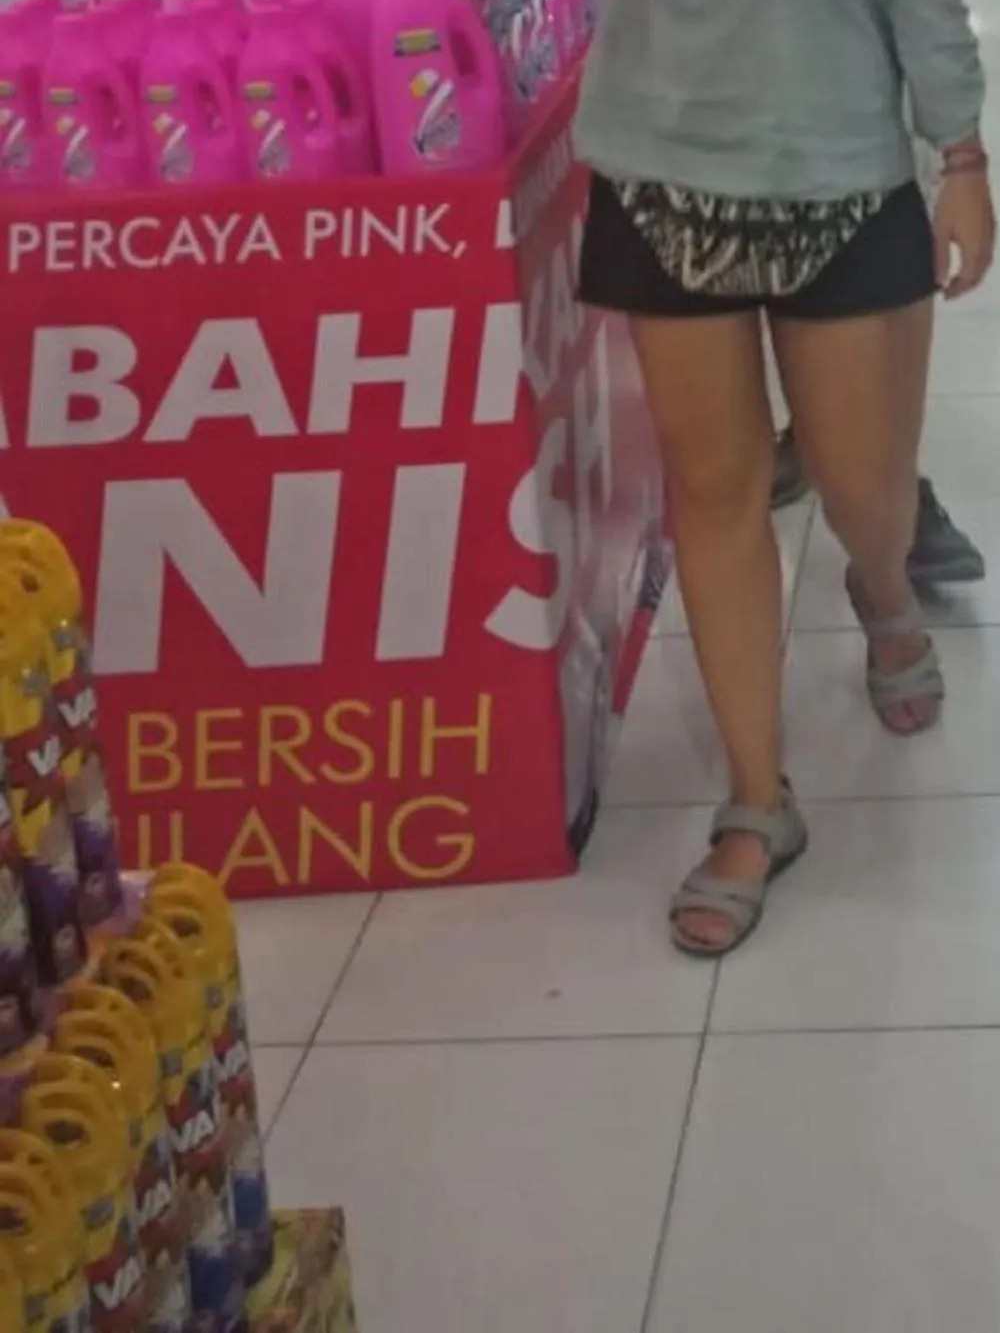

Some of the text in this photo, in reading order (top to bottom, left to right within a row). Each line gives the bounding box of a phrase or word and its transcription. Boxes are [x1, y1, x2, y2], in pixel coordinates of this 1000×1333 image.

[9, 203, 468, 271] PERCAYA PINK,
[126, 693, 491, 794] BERSIH
